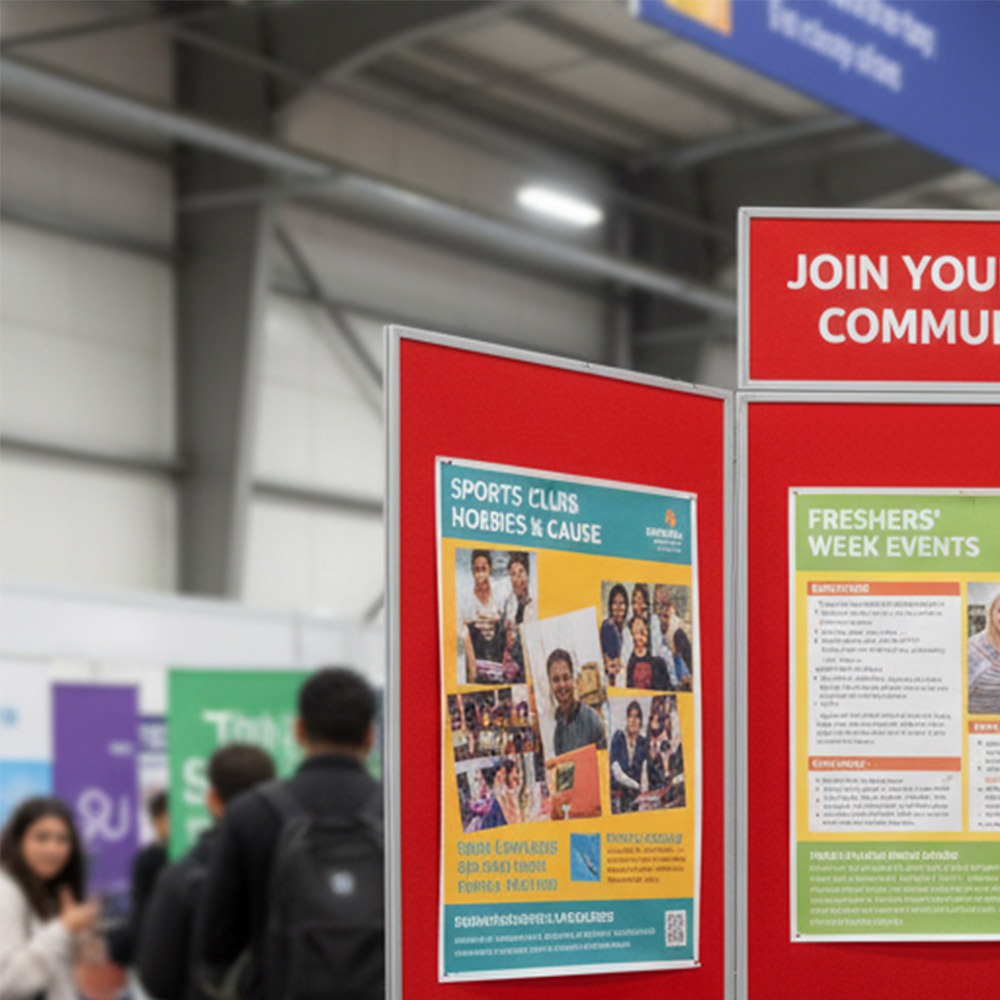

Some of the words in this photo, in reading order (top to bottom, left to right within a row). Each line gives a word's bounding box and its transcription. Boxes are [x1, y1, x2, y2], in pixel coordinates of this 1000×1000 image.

[787, 253, 888, 290] JOIN
[451, 477, 523, 507] SPORTS
[547, 519, 602, 544] CAUSE
[808, 508, 941, 531] FRESHERS'
[808, 535, 879, 557] WEEK
[886, 536, 981, 558] EVENTS
